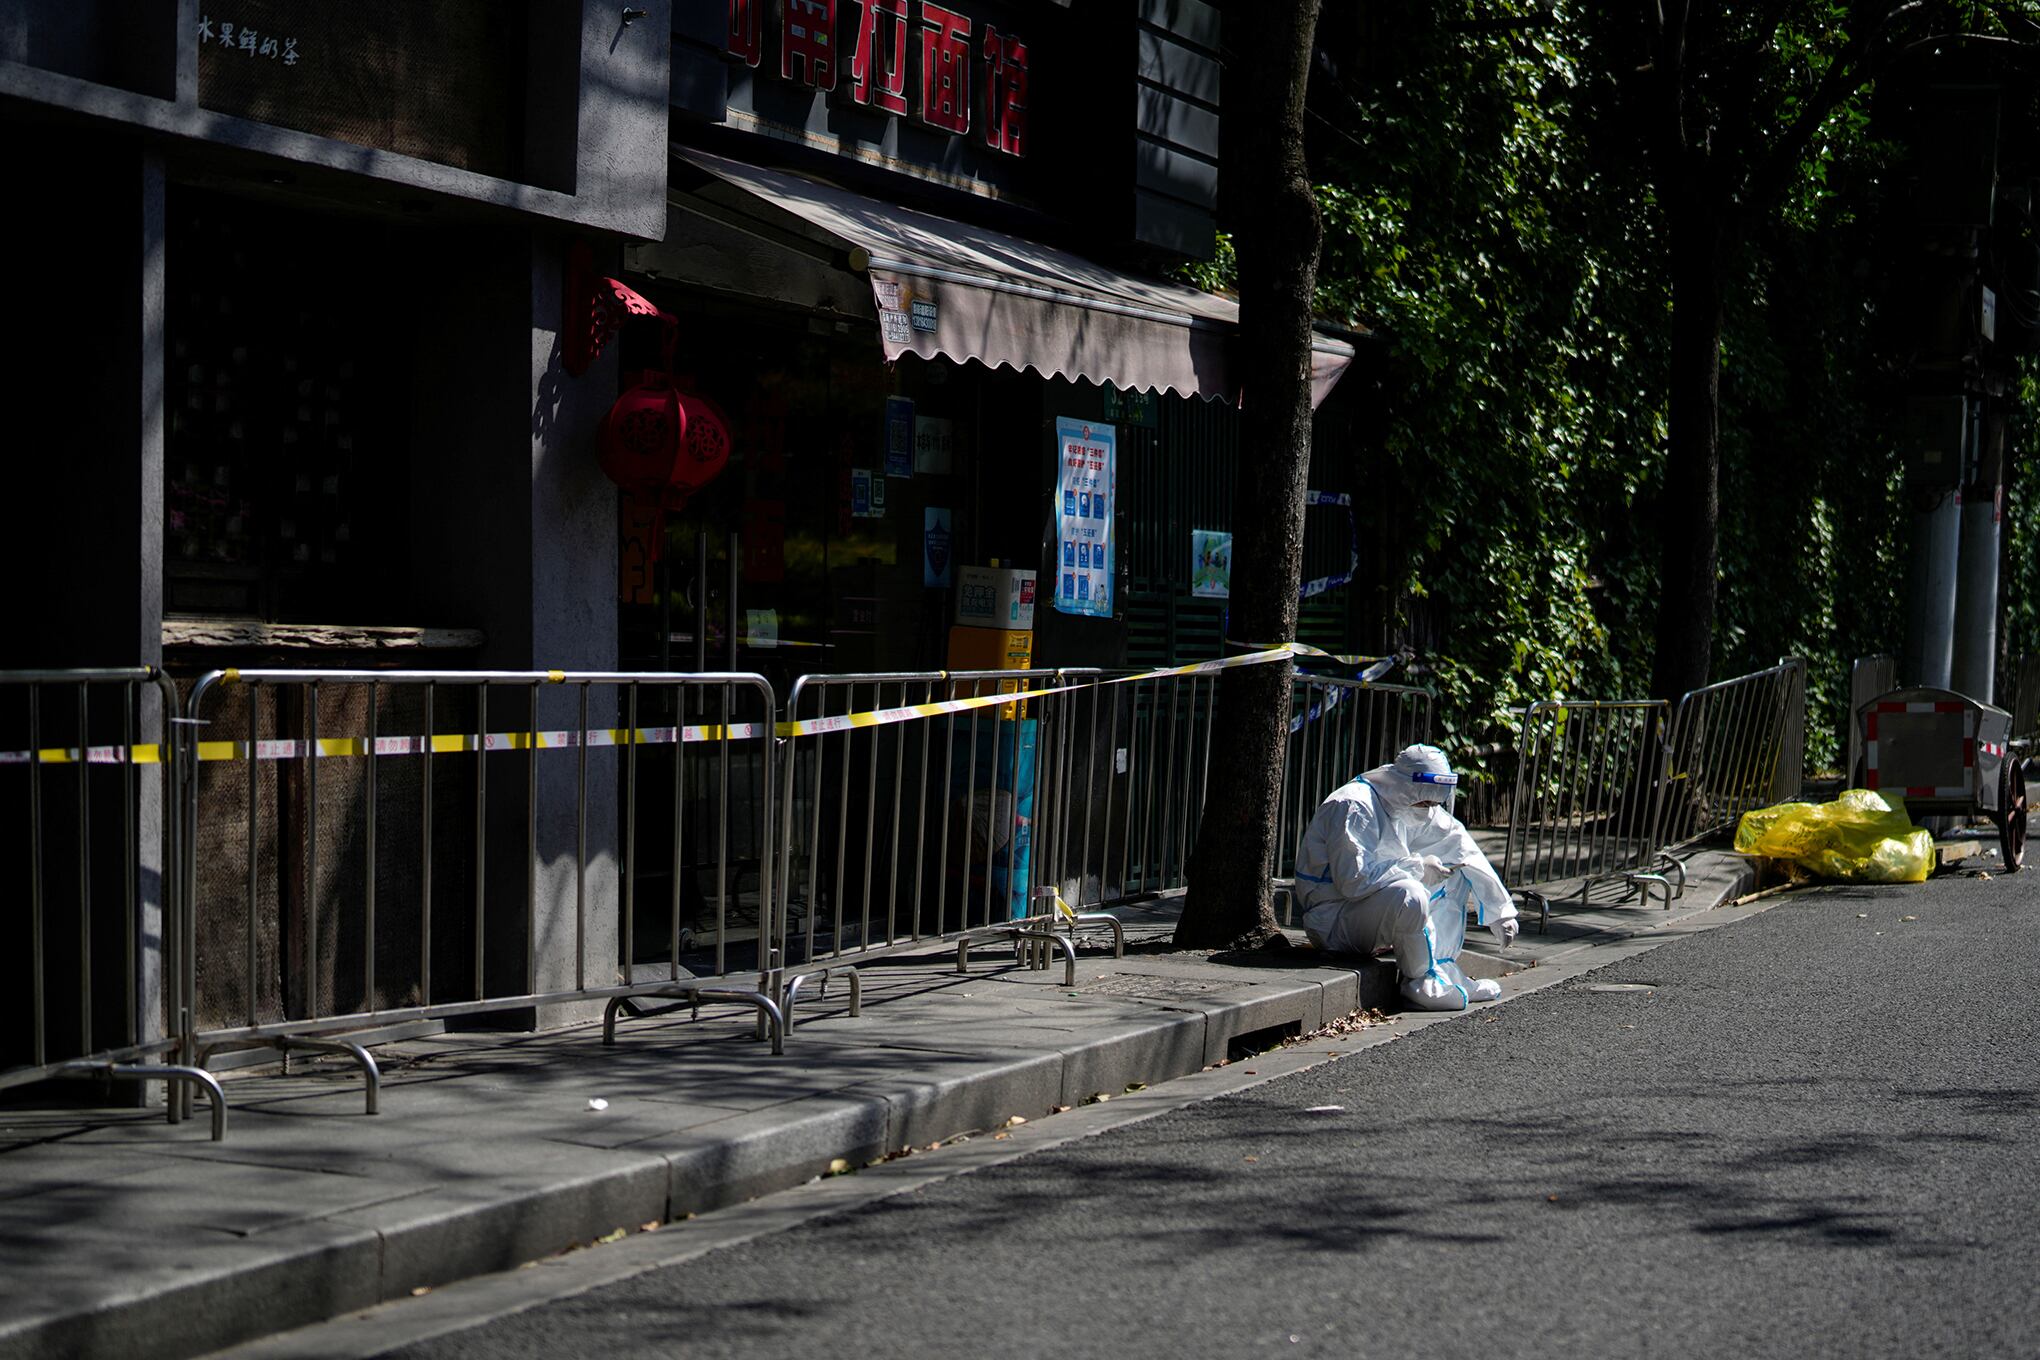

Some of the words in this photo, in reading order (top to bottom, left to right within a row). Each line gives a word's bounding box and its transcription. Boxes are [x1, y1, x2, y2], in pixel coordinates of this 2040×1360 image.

[198, 14, 301, 66] 水果鲜奶茶
